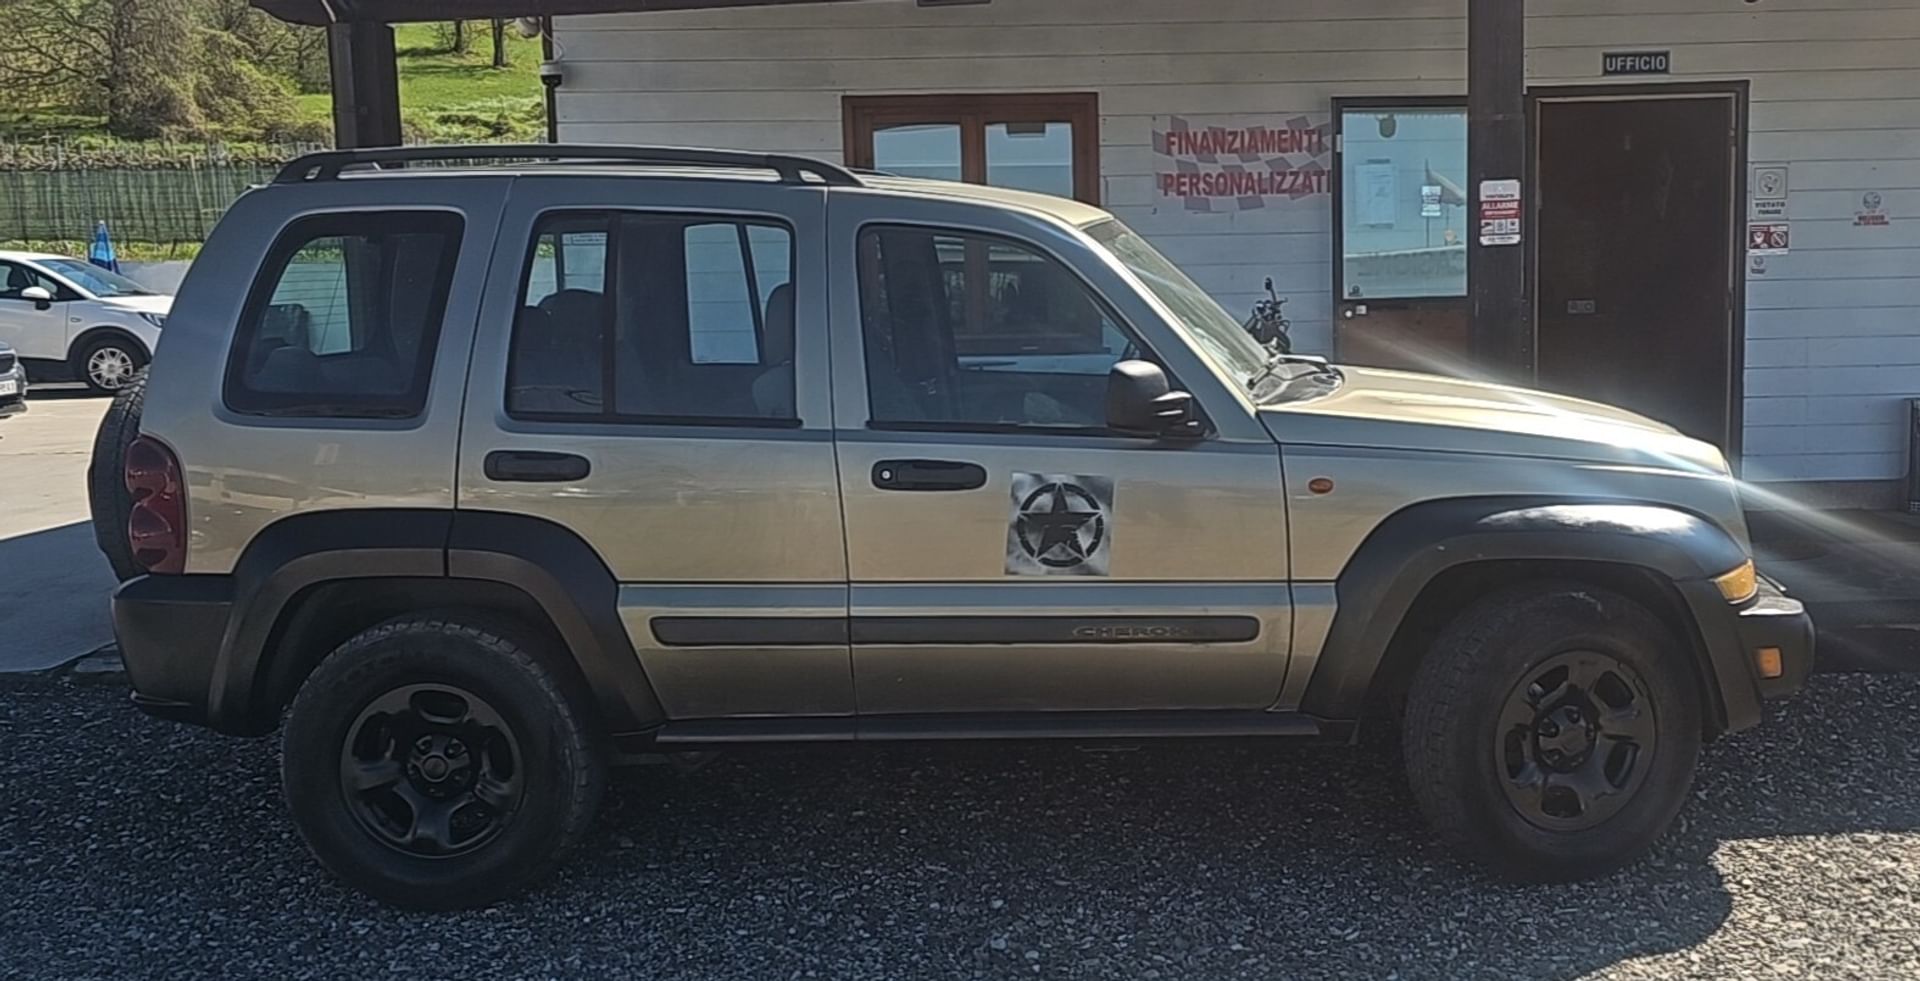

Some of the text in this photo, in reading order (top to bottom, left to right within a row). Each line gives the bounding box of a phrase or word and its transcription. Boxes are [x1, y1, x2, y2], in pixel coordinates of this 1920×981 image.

[1606, 56, 1666, 71] UFFICIO
[1166, 129, 1322, 155] FINANZIAMENTI
[1163, 170, 1331, 196] PERSONALIZZATI
[1755, 201, 1786, 209] VIETATO
